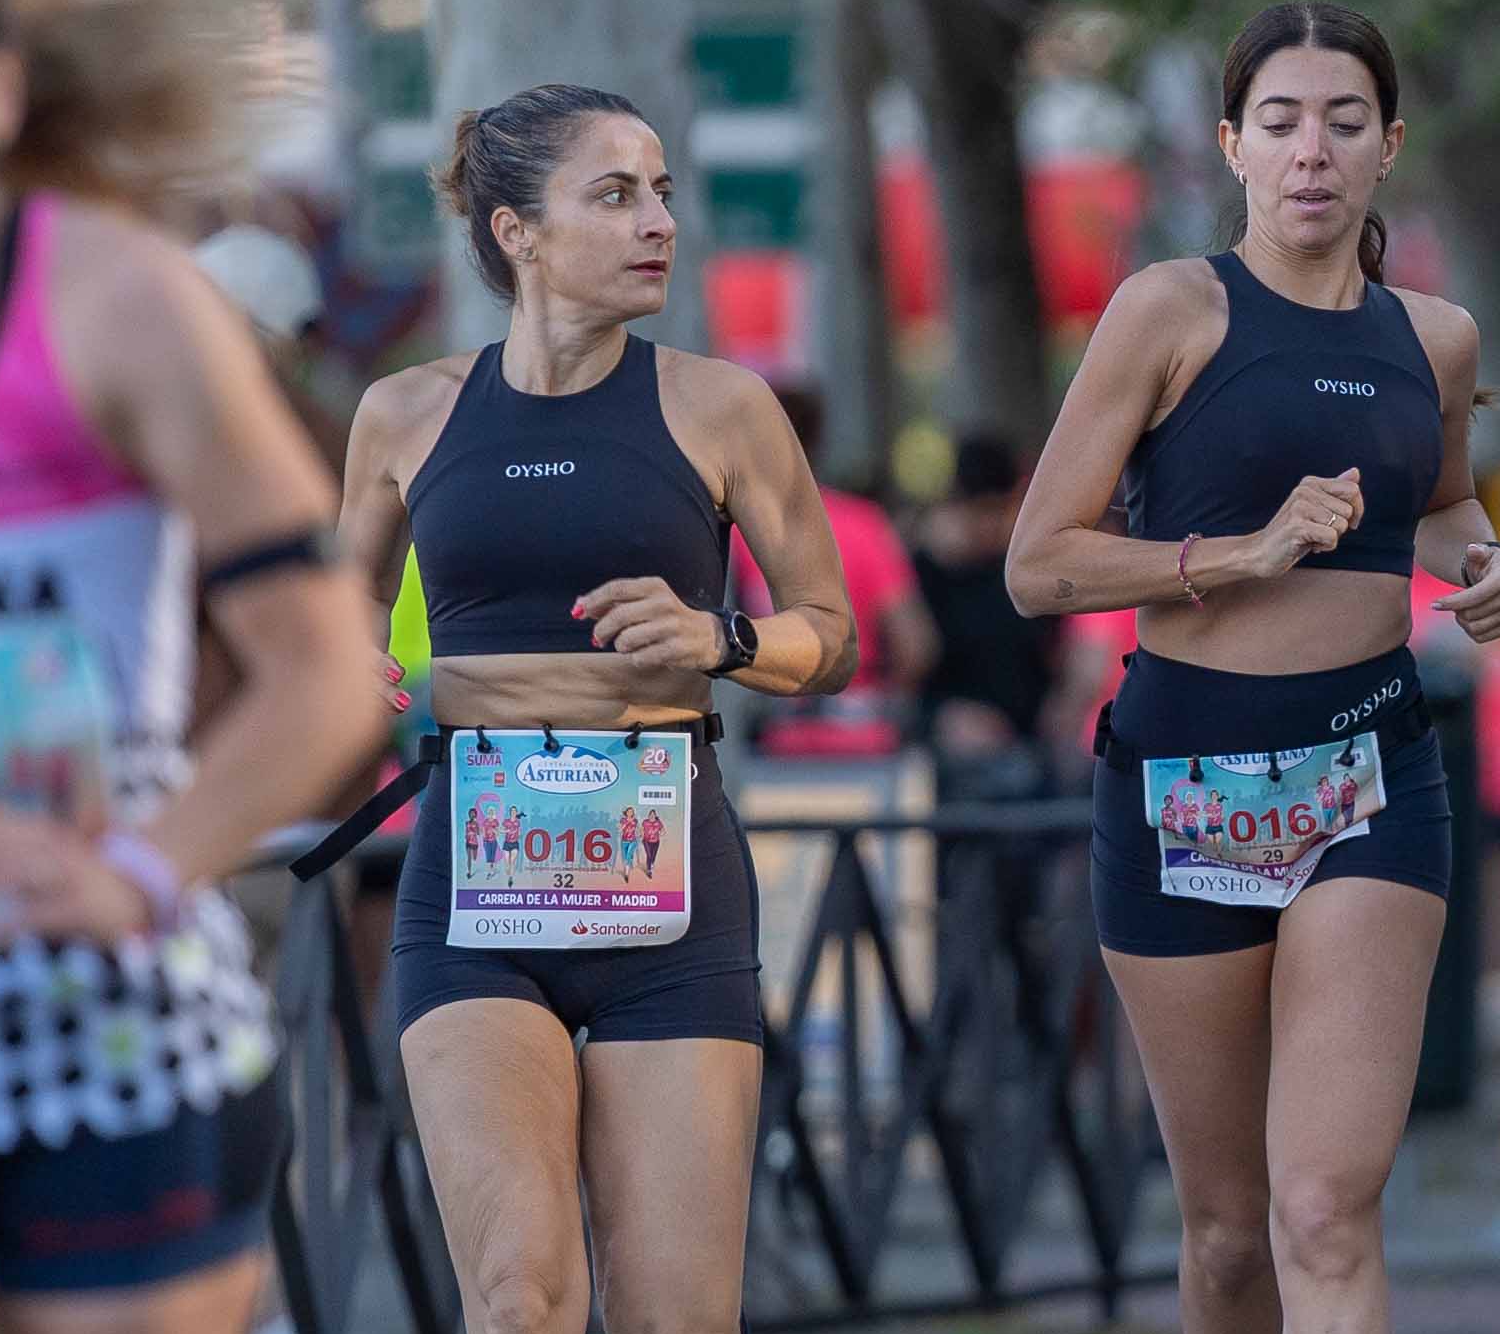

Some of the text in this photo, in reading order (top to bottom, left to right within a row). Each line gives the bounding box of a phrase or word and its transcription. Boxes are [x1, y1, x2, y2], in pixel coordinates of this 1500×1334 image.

[1314, 378, 1375, 397] OYSHO
[505, 461, 575, 478] OYSHO
[1331, 678, 1402, 731] OYSHO
[467, 755, 502, 766] SUMA
[643, 747, 666, 764] 20
[522, 763, 612, 784] ASTURIANA
[1229, 803, 1317, 843] 016
[524, 828, 613, 863] 016
[1263, 850, 1284, 863] 29
[553, 873, 574, 888] 32
[1189, 874, 1261, 893] OYSHO
[478, 893, 658, 907] CARRERA DE LA MUJER MADRID
[475, 918, 661, 936] OYSHO Santander
